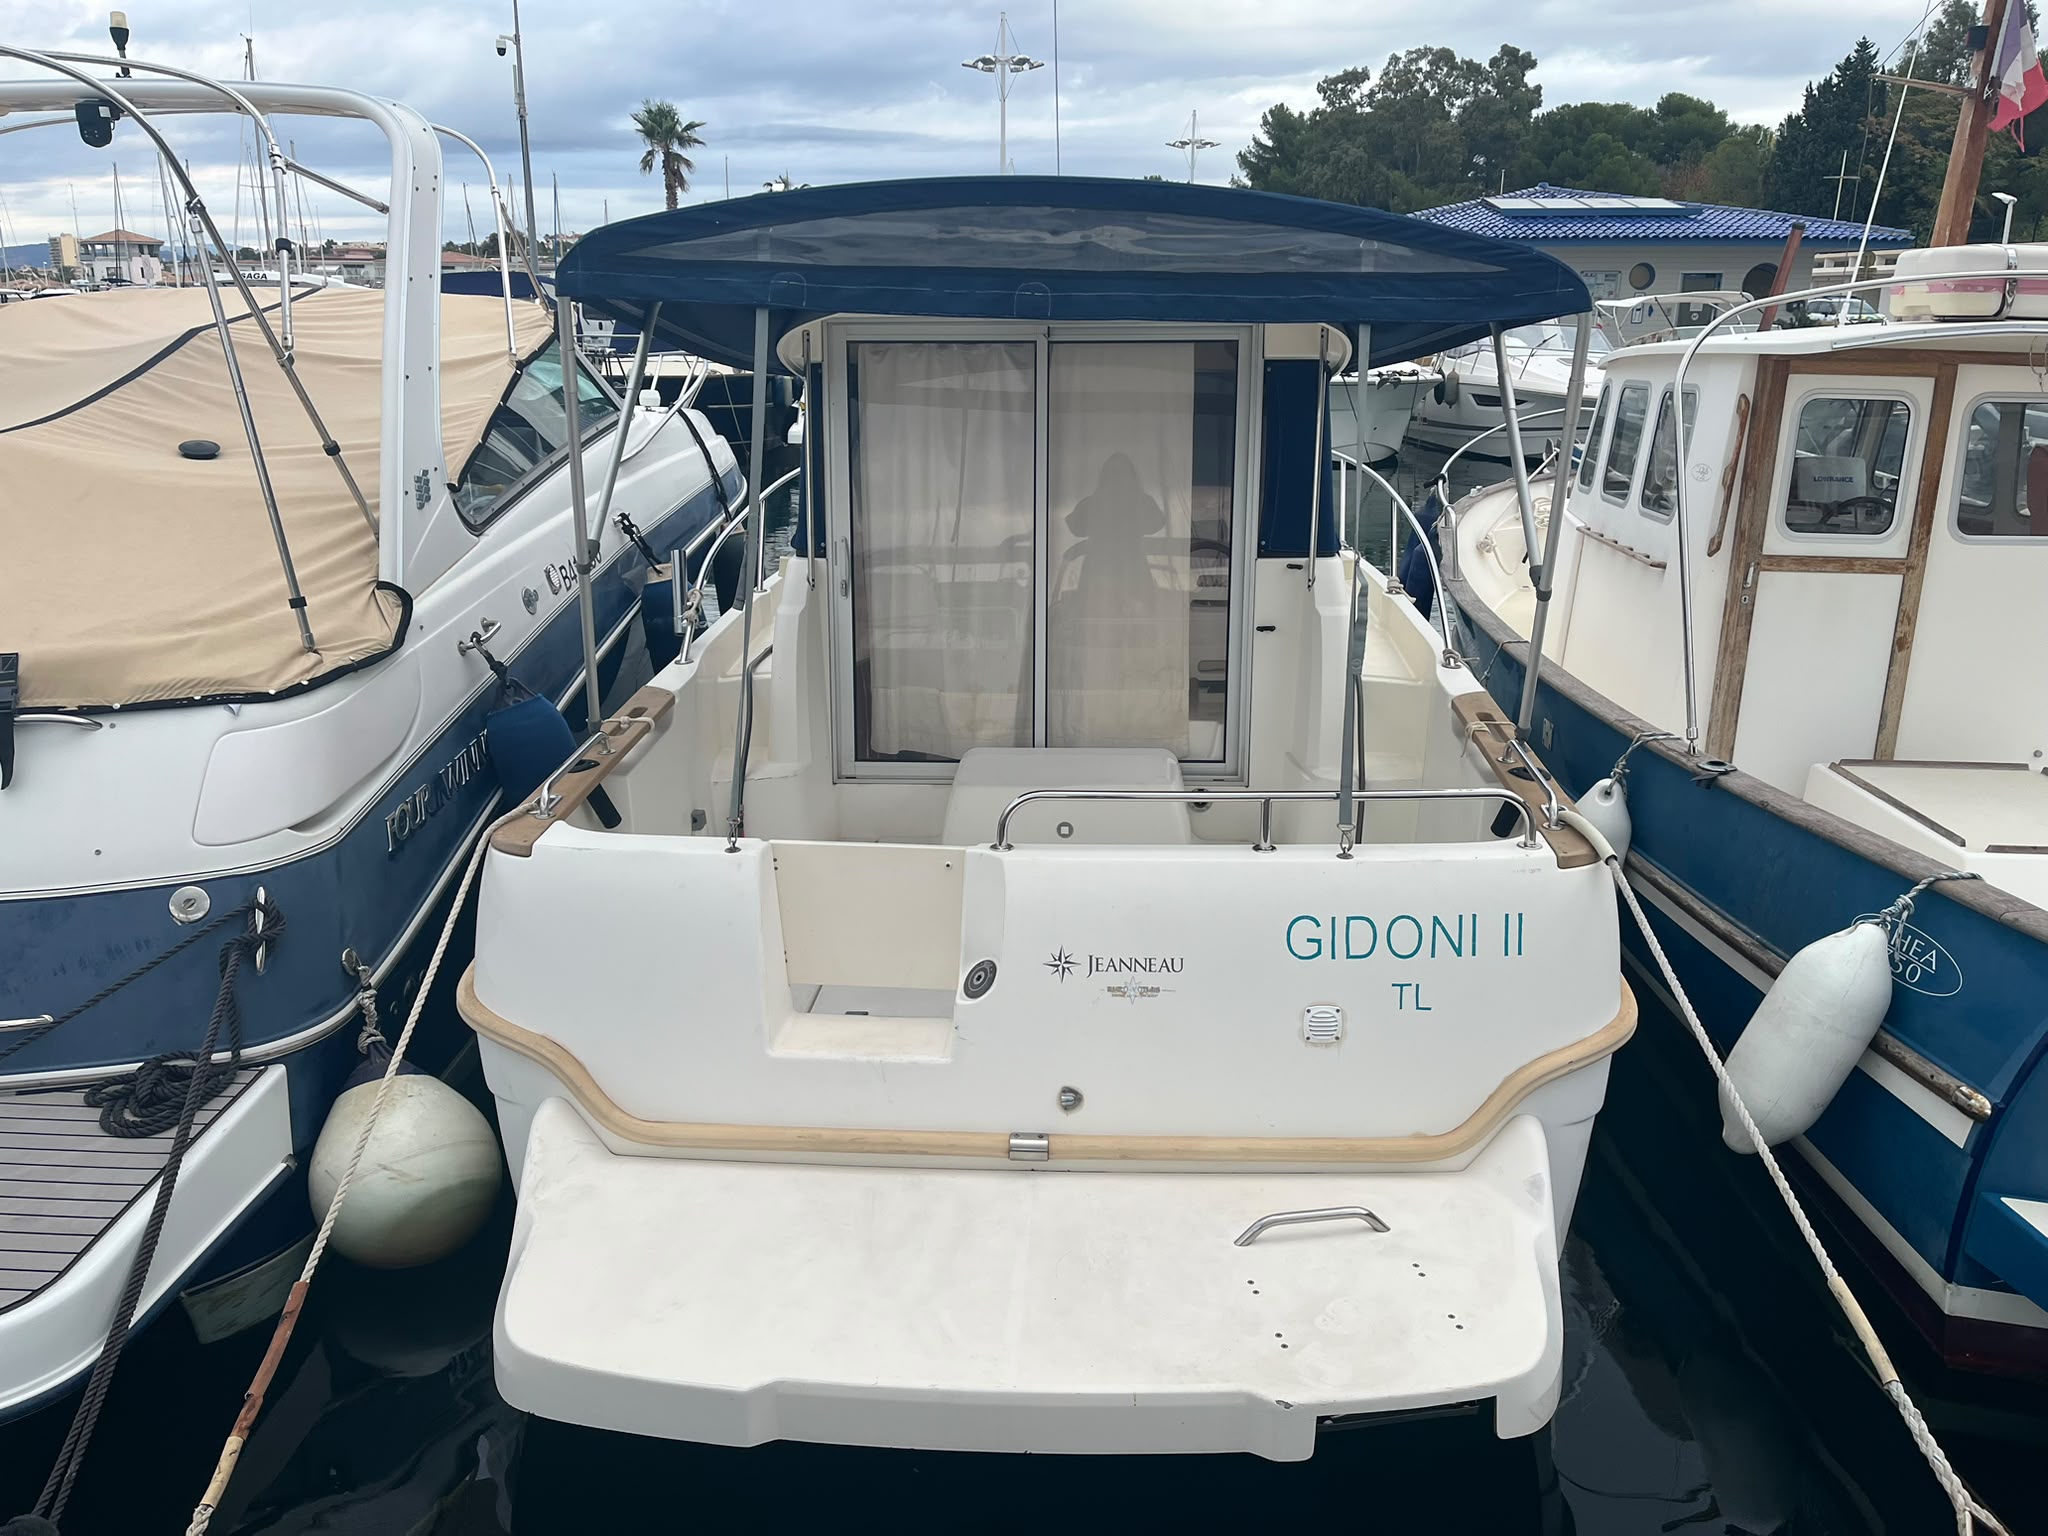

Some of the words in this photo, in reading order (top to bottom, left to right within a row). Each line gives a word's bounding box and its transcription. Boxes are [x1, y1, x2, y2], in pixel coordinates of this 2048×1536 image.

[1813, 475, 1855, 484] LOWRANCE
[385, 783, 436, 852] FOUR
[439, 729, 488, 798] WINN
[1286, 913, 1477, 961] GIDONI
[1504, 912, 1523, 957] II
[1086, 954, 1185, 979] JEANNEAU
[1391, 982, 1433, 1011] TL
